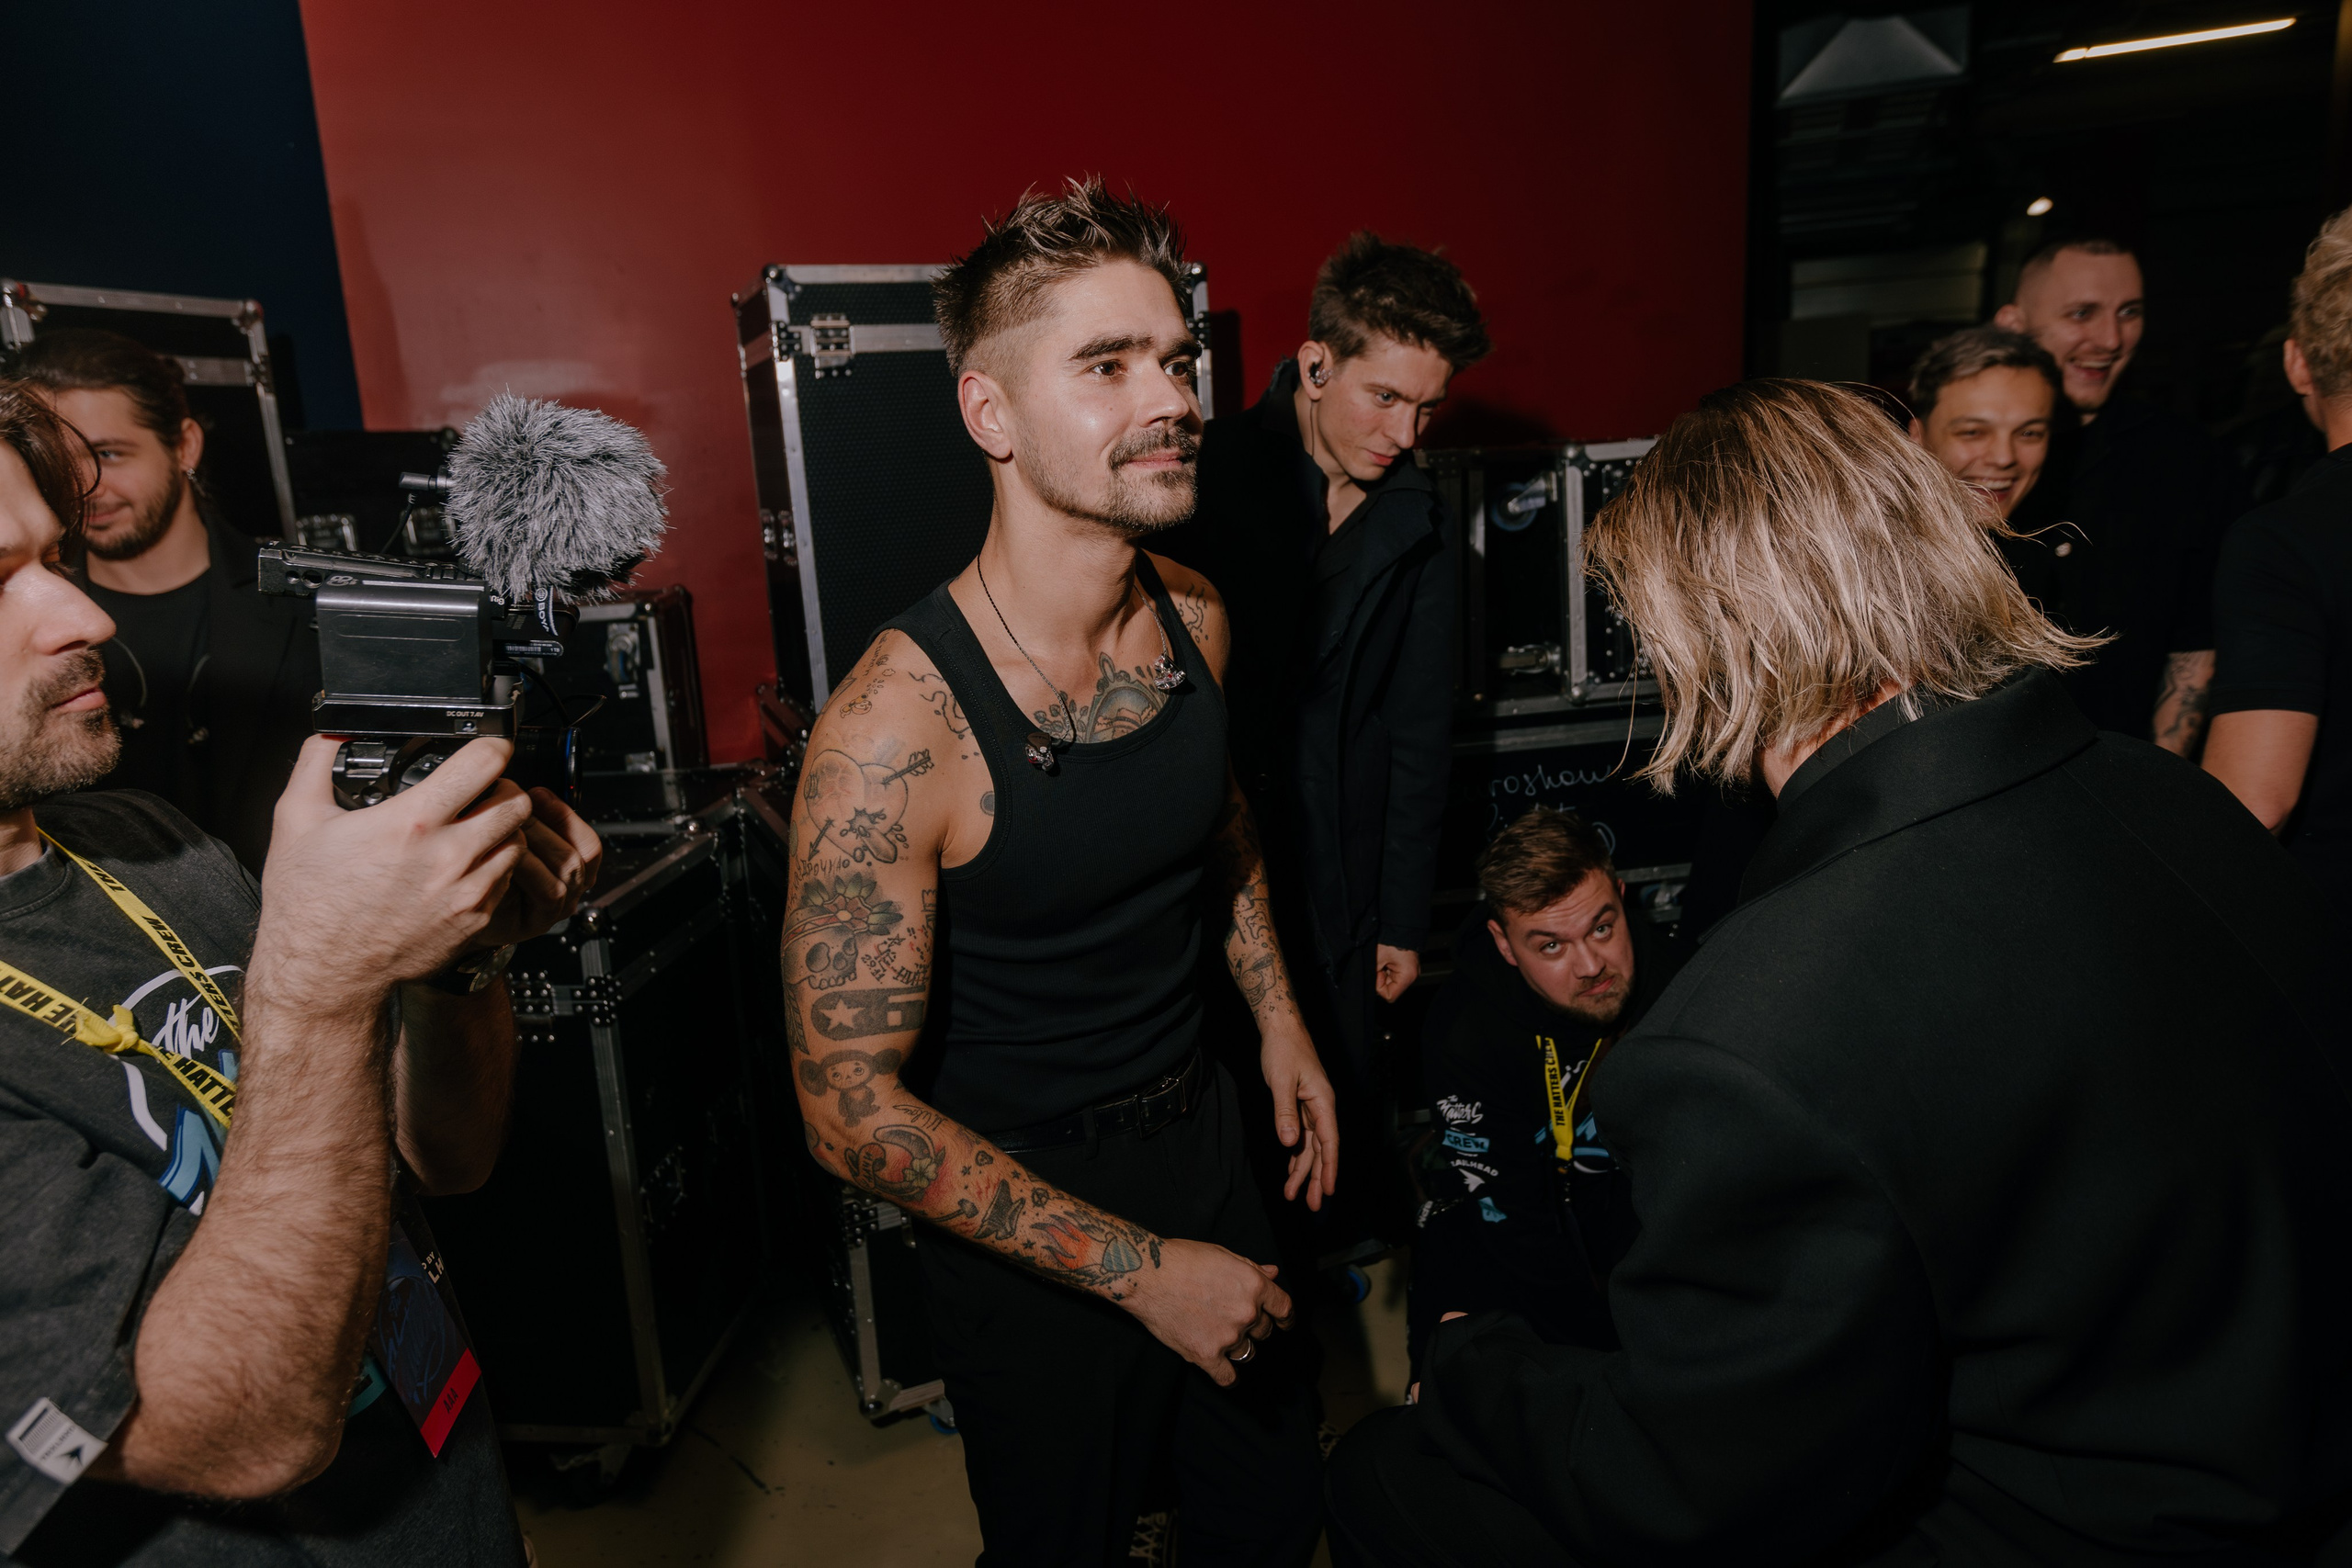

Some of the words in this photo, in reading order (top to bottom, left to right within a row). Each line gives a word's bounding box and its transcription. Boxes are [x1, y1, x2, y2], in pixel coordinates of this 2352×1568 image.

[537, 603, 550, 633] BOYA
[141, 915, 196, 968] CREW
[152, 993, 220, 1060] the
[1547, 1067, 1564, 1106] HATTERS
[1555, 1107, 1566, 1126] THE
[1446, 1134, 1486, 1149] CREW
[425, 1250, 435, 1265] BY
